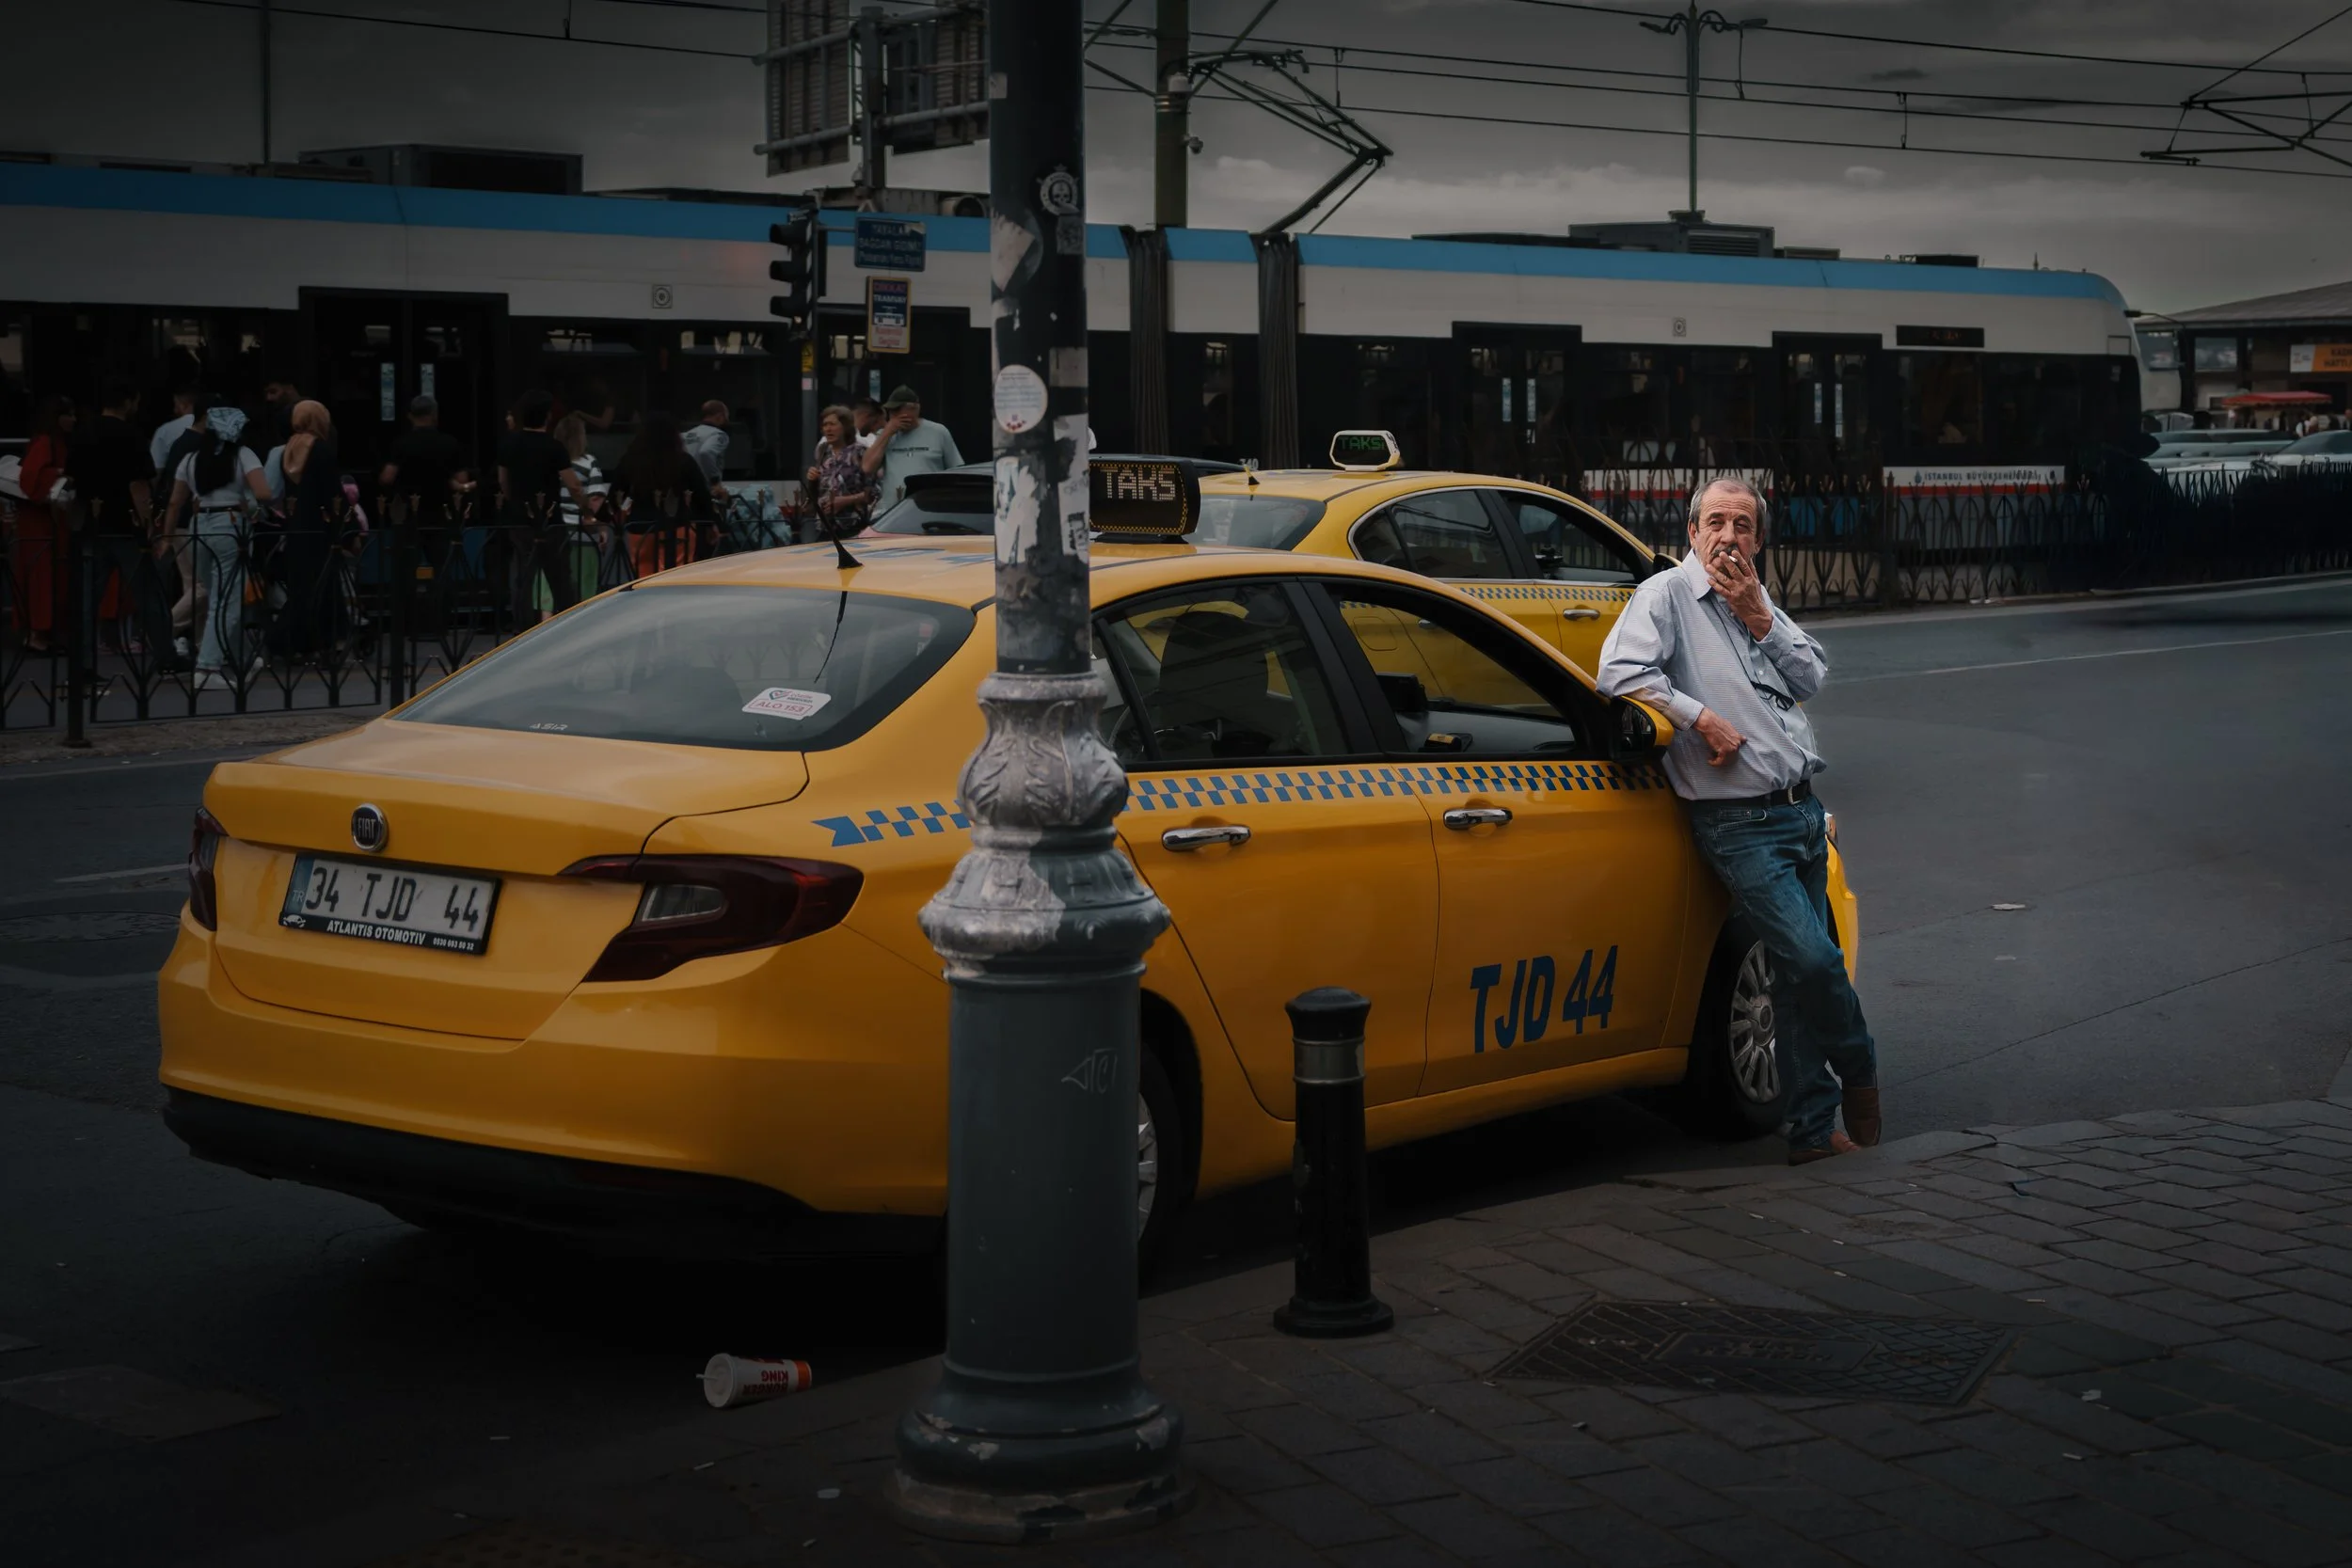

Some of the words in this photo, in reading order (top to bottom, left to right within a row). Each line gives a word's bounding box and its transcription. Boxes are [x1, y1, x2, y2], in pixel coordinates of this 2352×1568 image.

[1100, 467, 1175, 501] TAKS
[757, 701, 782, 709] ALO
[784, 705, 805, 713] 153
[358, 816, 376, 839] FIAT
[293, 889, 305, 903] TR
[306, 867, 340, 912] 34
[362, 873, 416, 922] TJD
[444, 884, 479, 932] 44
[1470, 956, 1555, 1053] TJD
[1563, 944, 1618, 1035] 44
[761, 1370, 788, 1382] KING
[742, 1383, 787, 1395] BURGER
